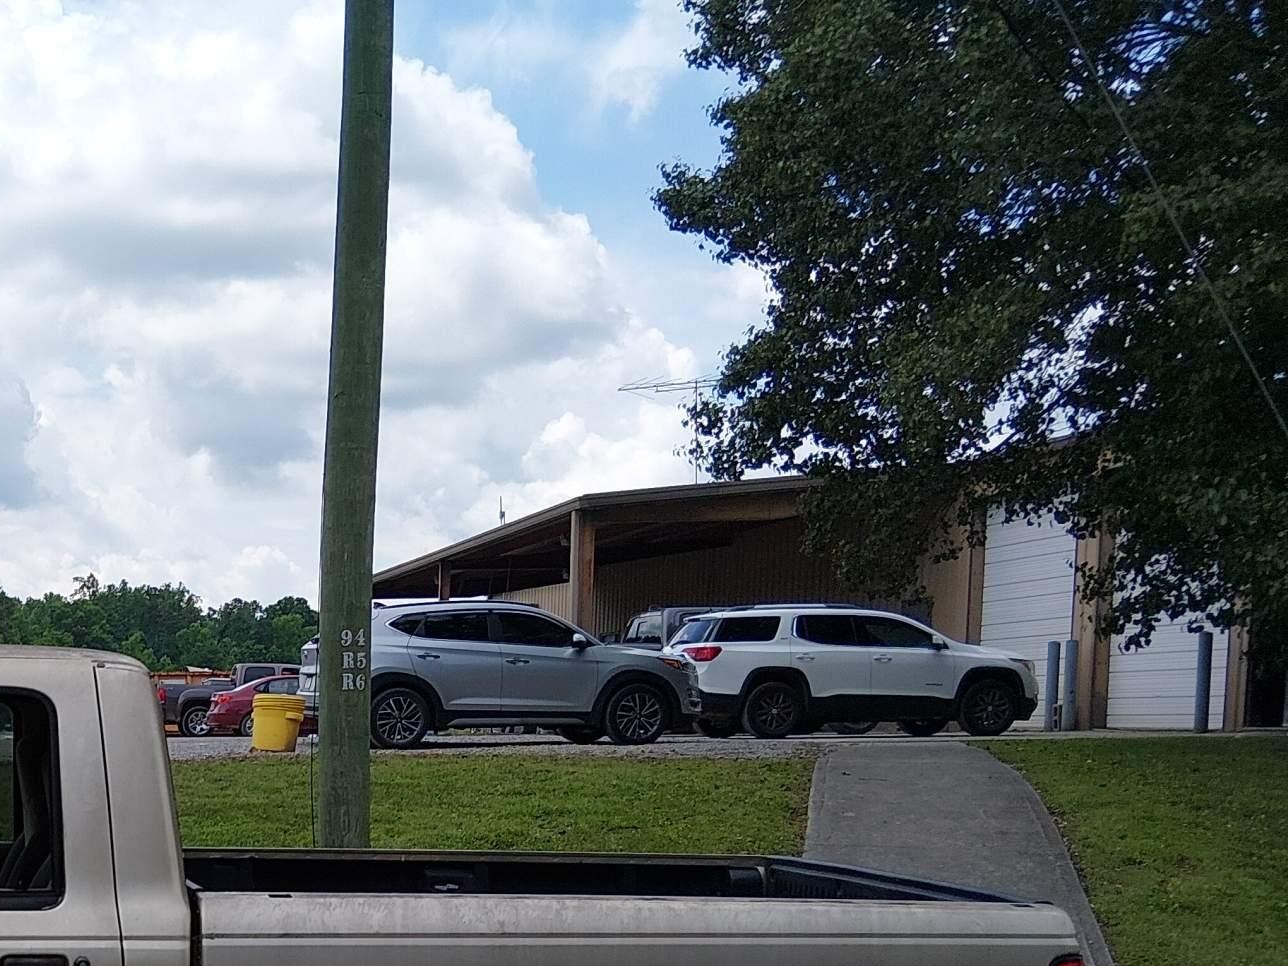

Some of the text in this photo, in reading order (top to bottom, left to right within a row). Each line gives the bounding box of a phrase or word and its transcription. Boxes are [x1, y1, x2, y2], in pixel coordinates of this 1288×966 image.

[340, 628, 366, 647] 94
[342, 651, 367, 669] R5
[342, 673, 366, 690] R6
